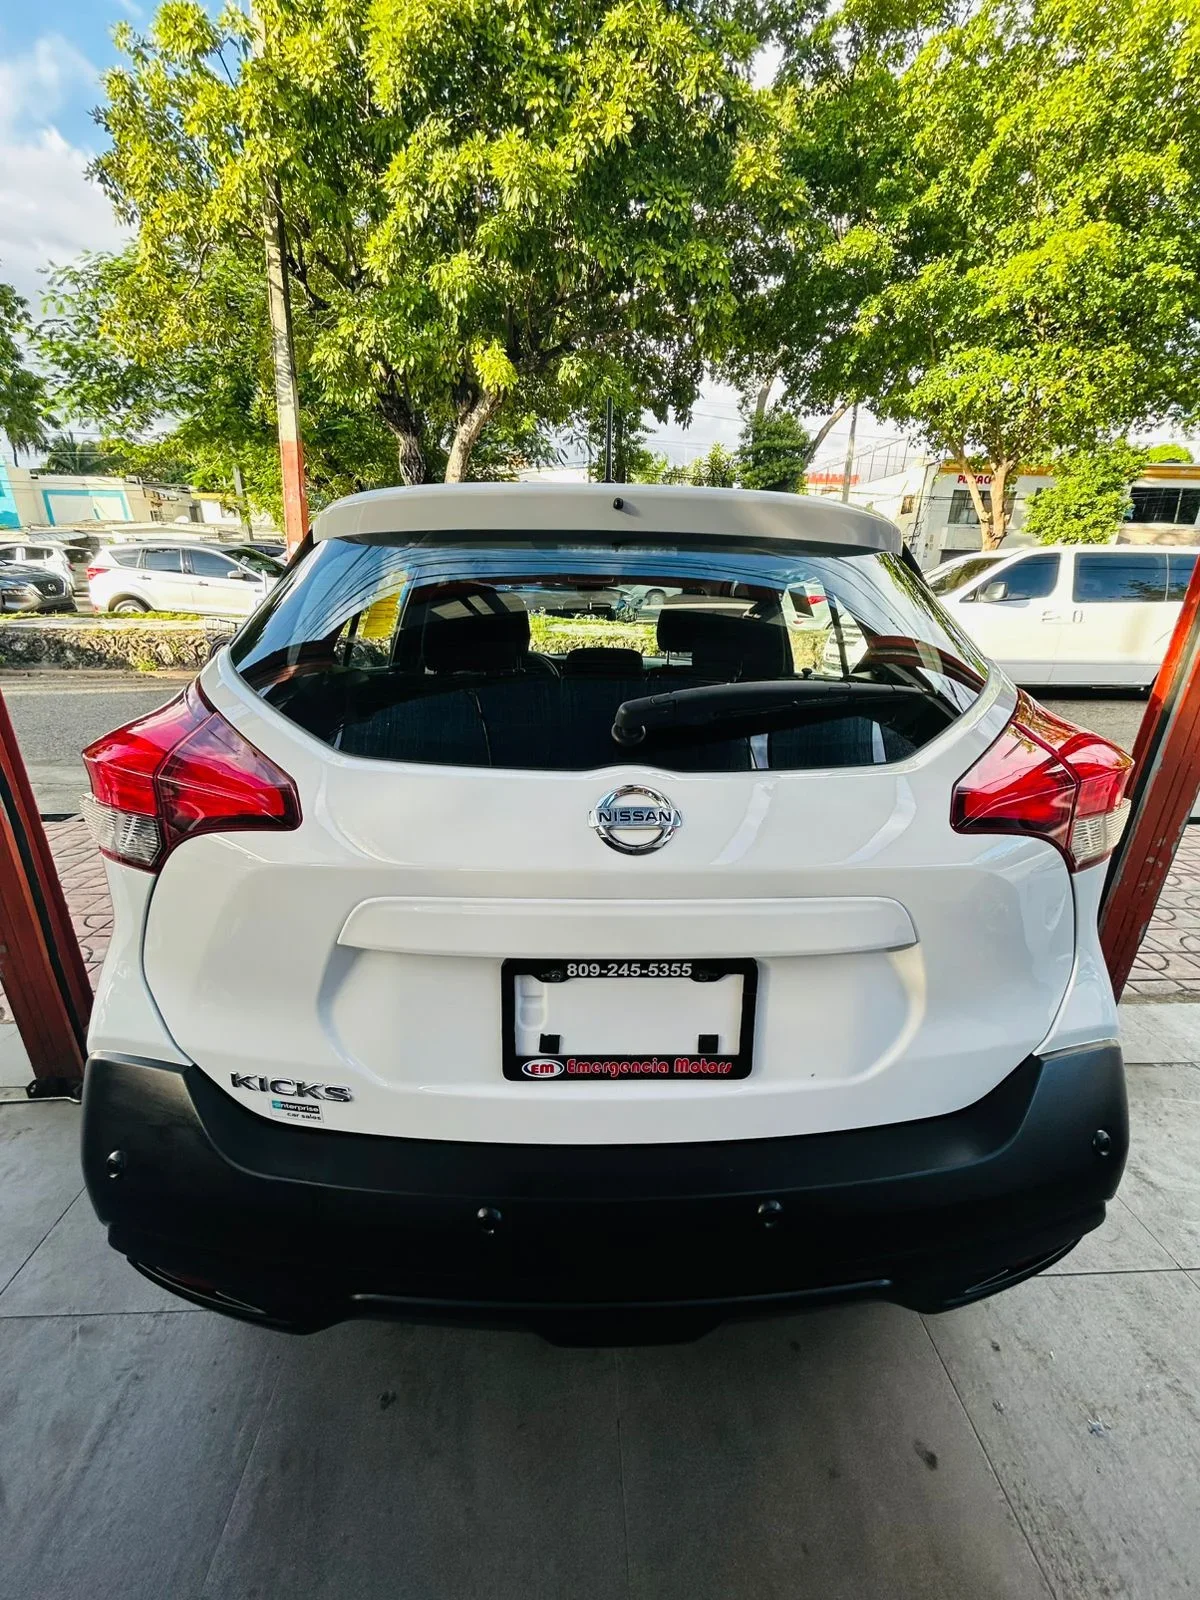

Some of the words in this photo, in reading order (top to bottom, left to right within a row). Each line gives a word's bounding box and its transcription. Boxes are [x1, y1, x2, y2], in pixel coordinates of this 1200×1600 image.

[599, 810, 672, 822] NISSAN
[567, 963, 692, 977] 809-245-5355
[530, 1064, 554, 1074] EM
[567, 1058, 669, 1077] Emergencia
[673, 1058, 732, 1074] Motors
[230, 1071, 352, 1102] KICKS
[272, 1101, 320, 1112] enterprise
